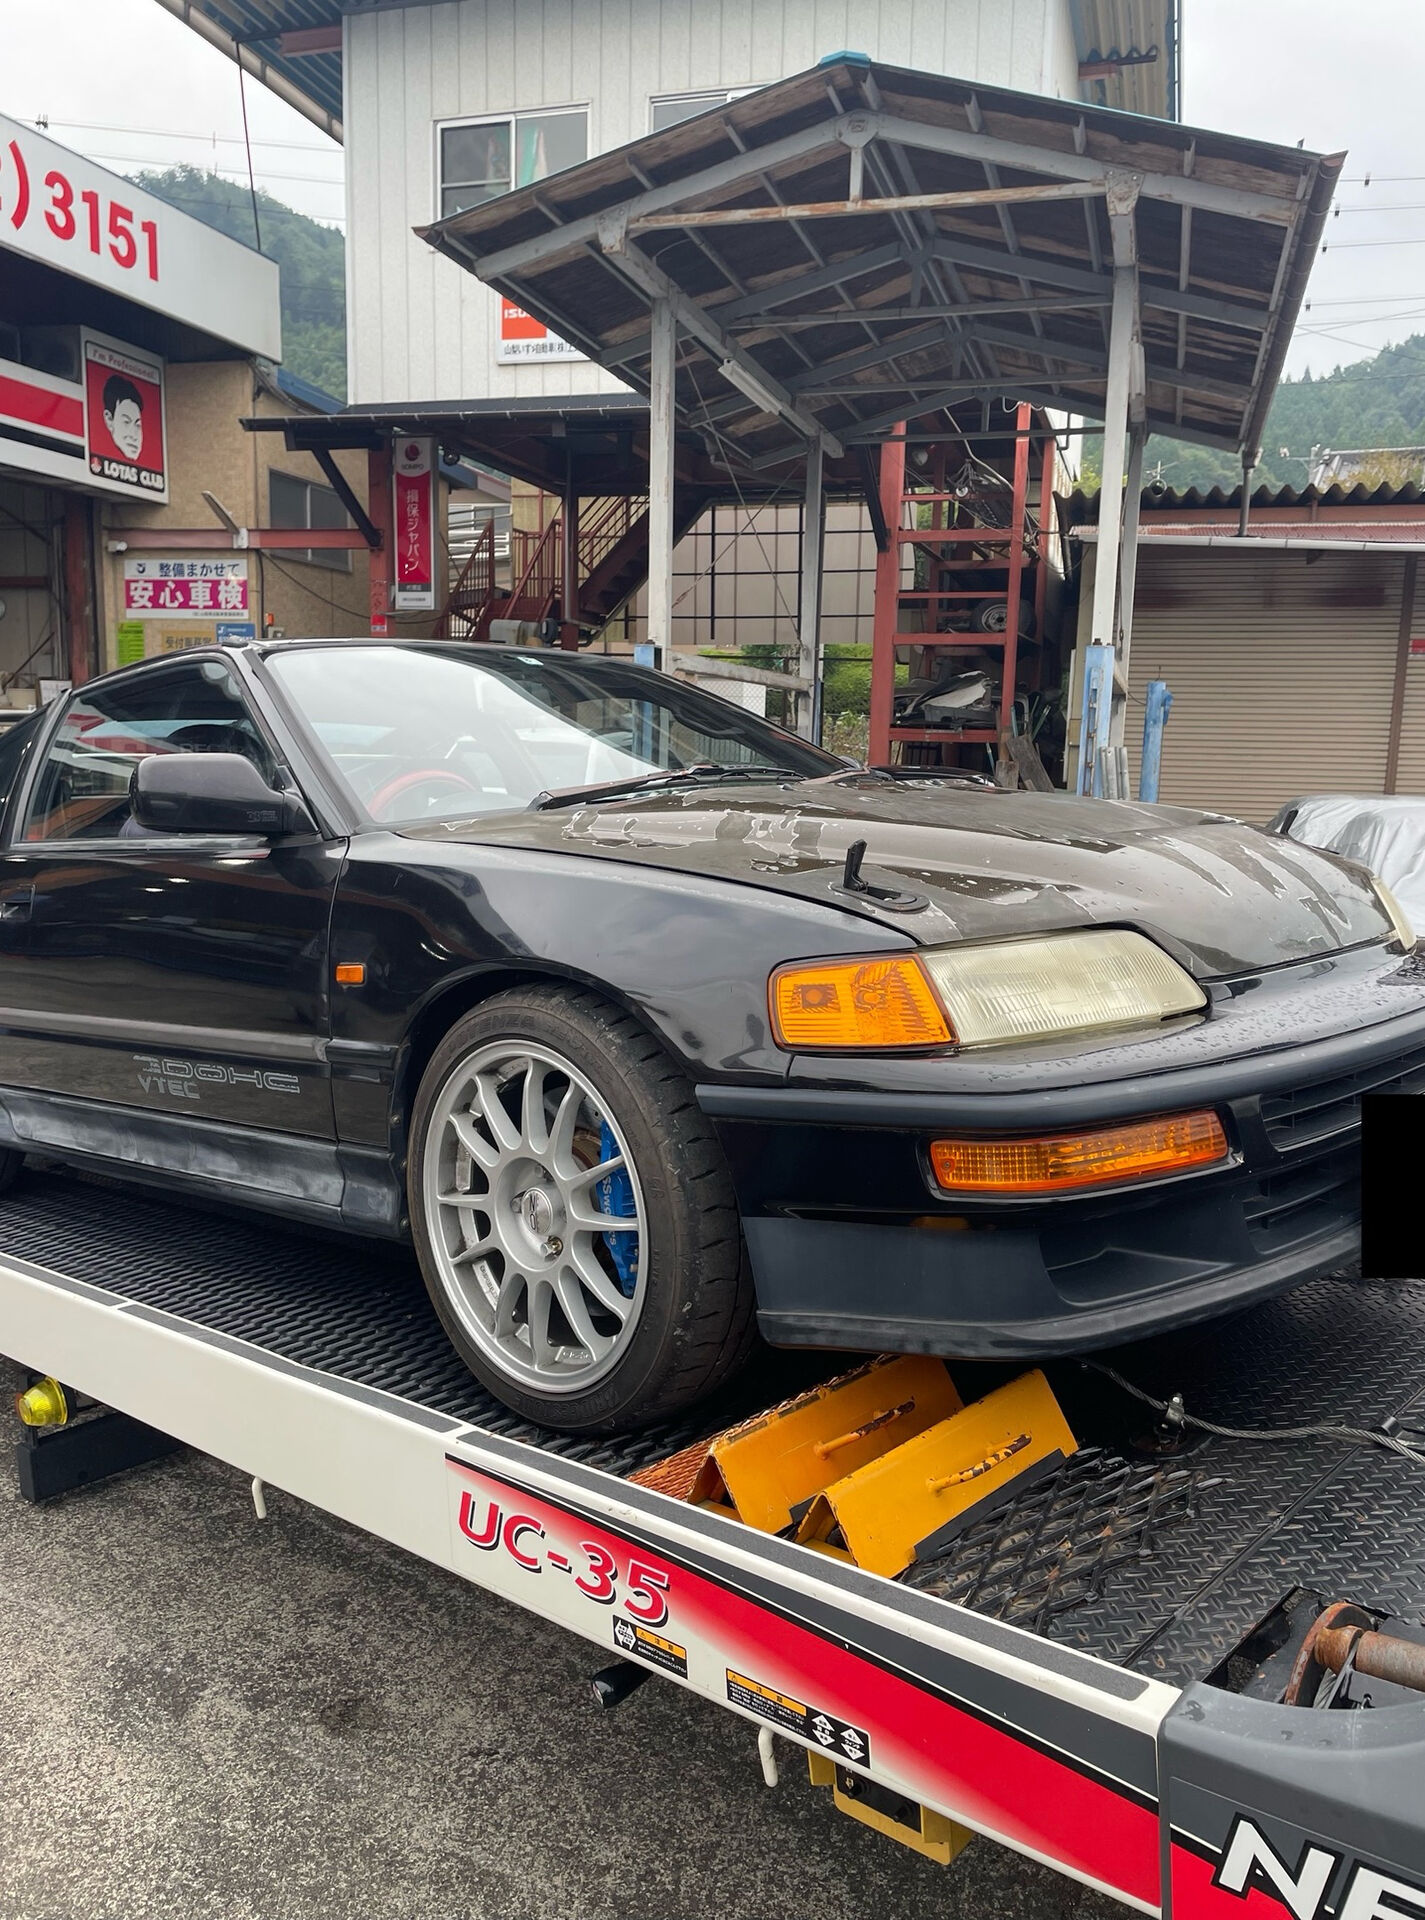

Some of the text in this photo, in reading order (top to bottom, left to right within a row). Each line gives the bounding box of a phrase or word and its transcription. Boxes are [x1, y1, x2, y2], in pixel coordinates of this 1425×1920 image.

[0, 140, 159, 282] )3151
[503, 307, 532, 319] ISU
[103, 460, 165, 490] LOTAS CLUB
[406, 488, 420, 574] 損保ジャパン
[159, 562, 240, 578] 整備まかせて
[129, 579, 244, 609] 安心車検
[137, 1074, 201, 1100] VTEC
[162, 1058, 301, 1094] DOHC
[458, 1490, 671, 1628] UC-35
